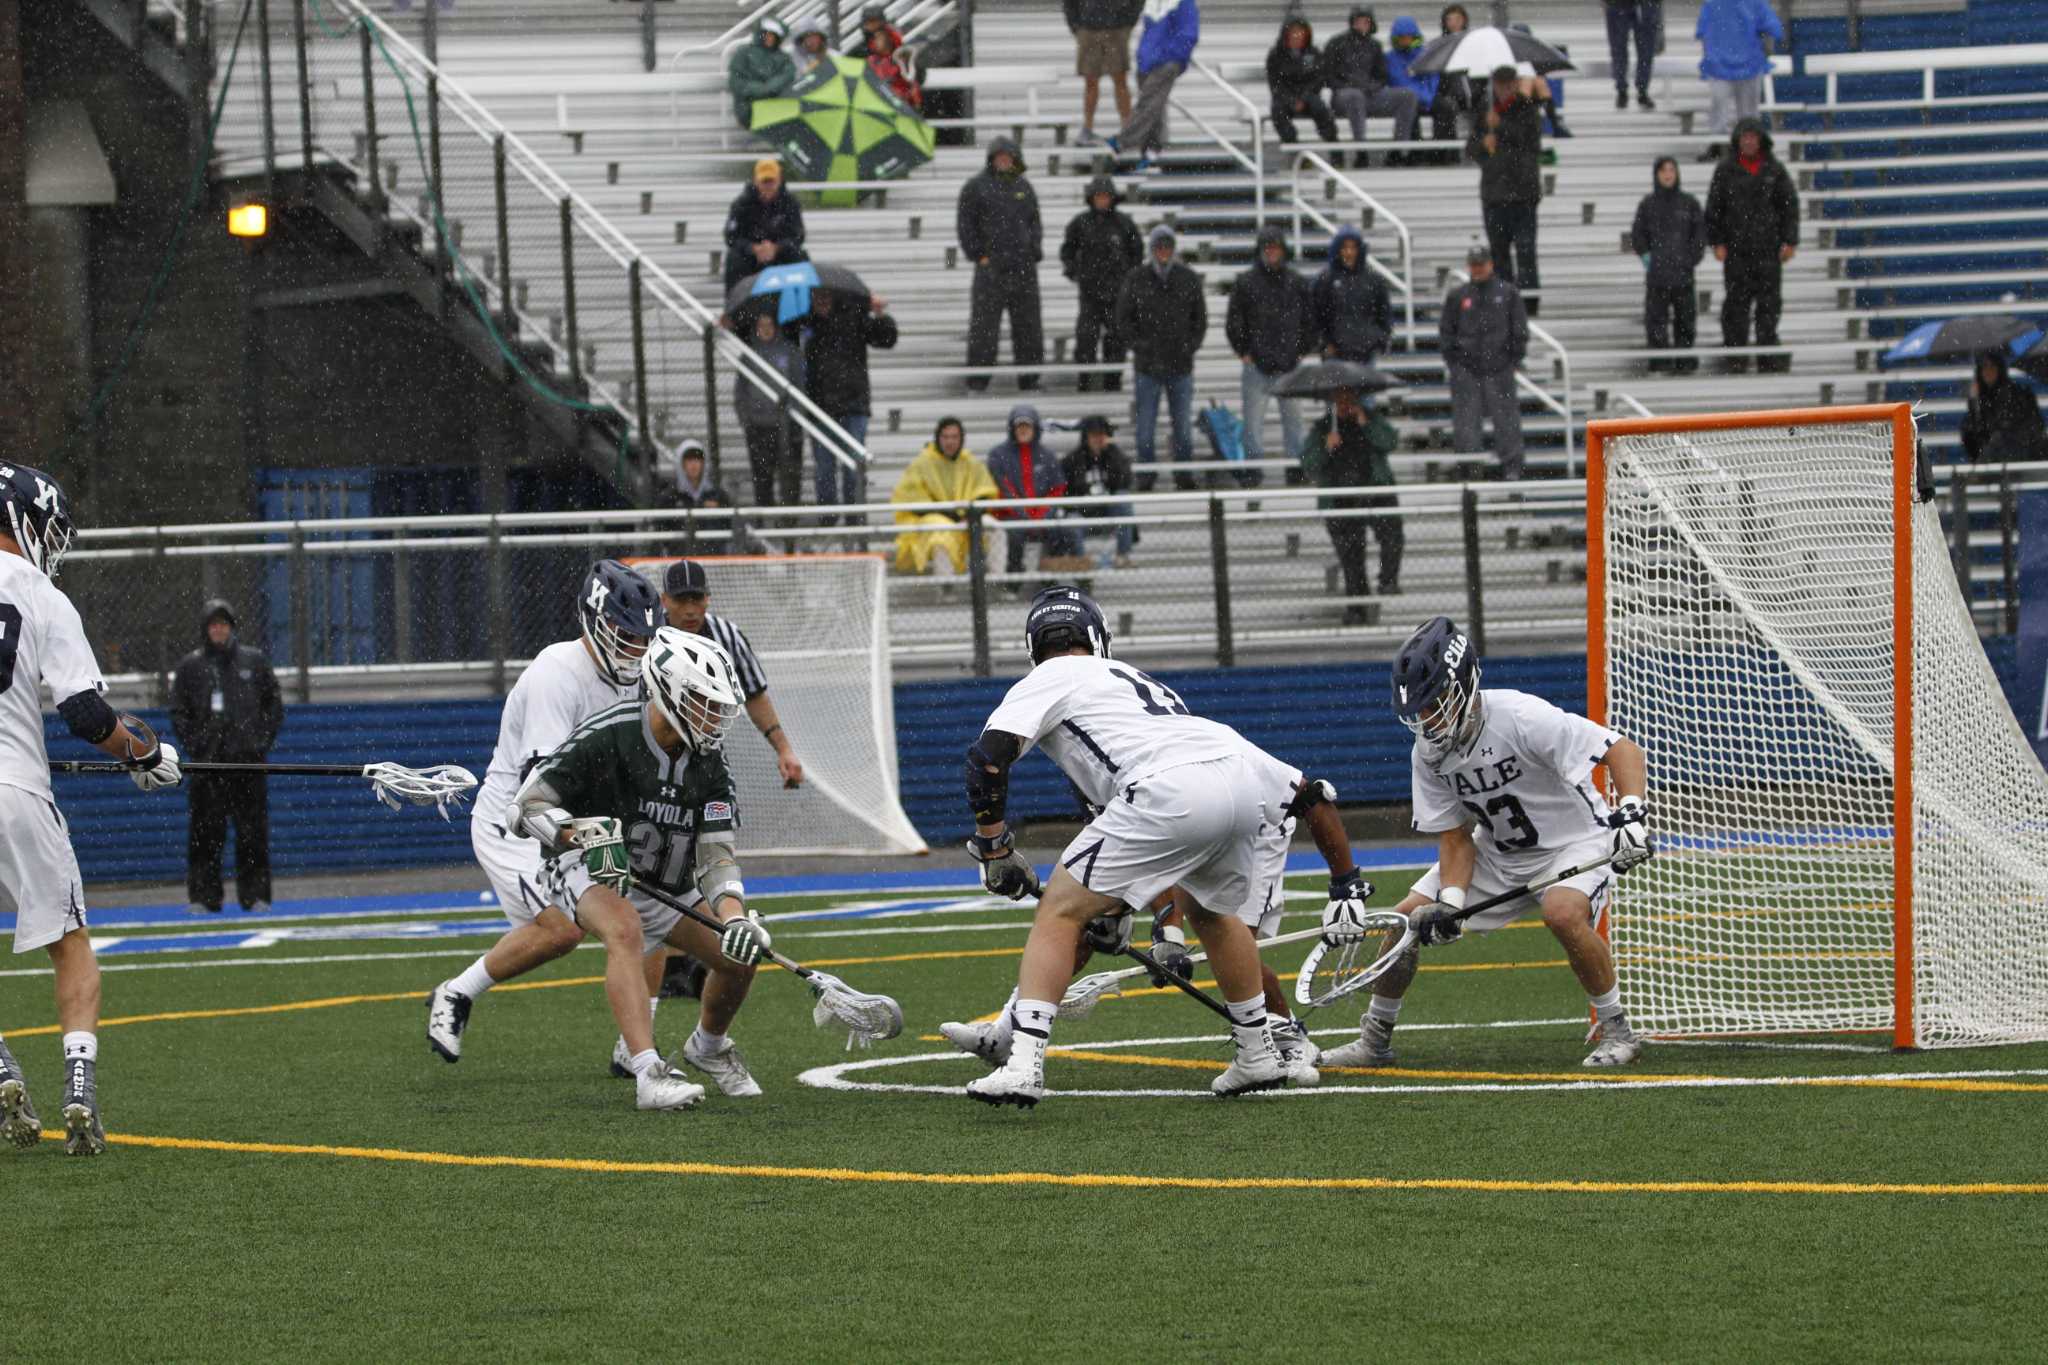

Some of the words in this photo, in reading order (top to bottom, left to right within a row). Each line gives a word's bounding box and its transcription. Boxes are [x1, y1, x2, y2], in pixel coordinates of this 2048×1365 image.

[1068, 592, 1079, 600] 11
[1444, 634, 1467, 669] Elis
[1109, 668, 1188, 715] 11
[638, 798, 694, 828] LOYOLA
[627, 820, 693, 887] 31
